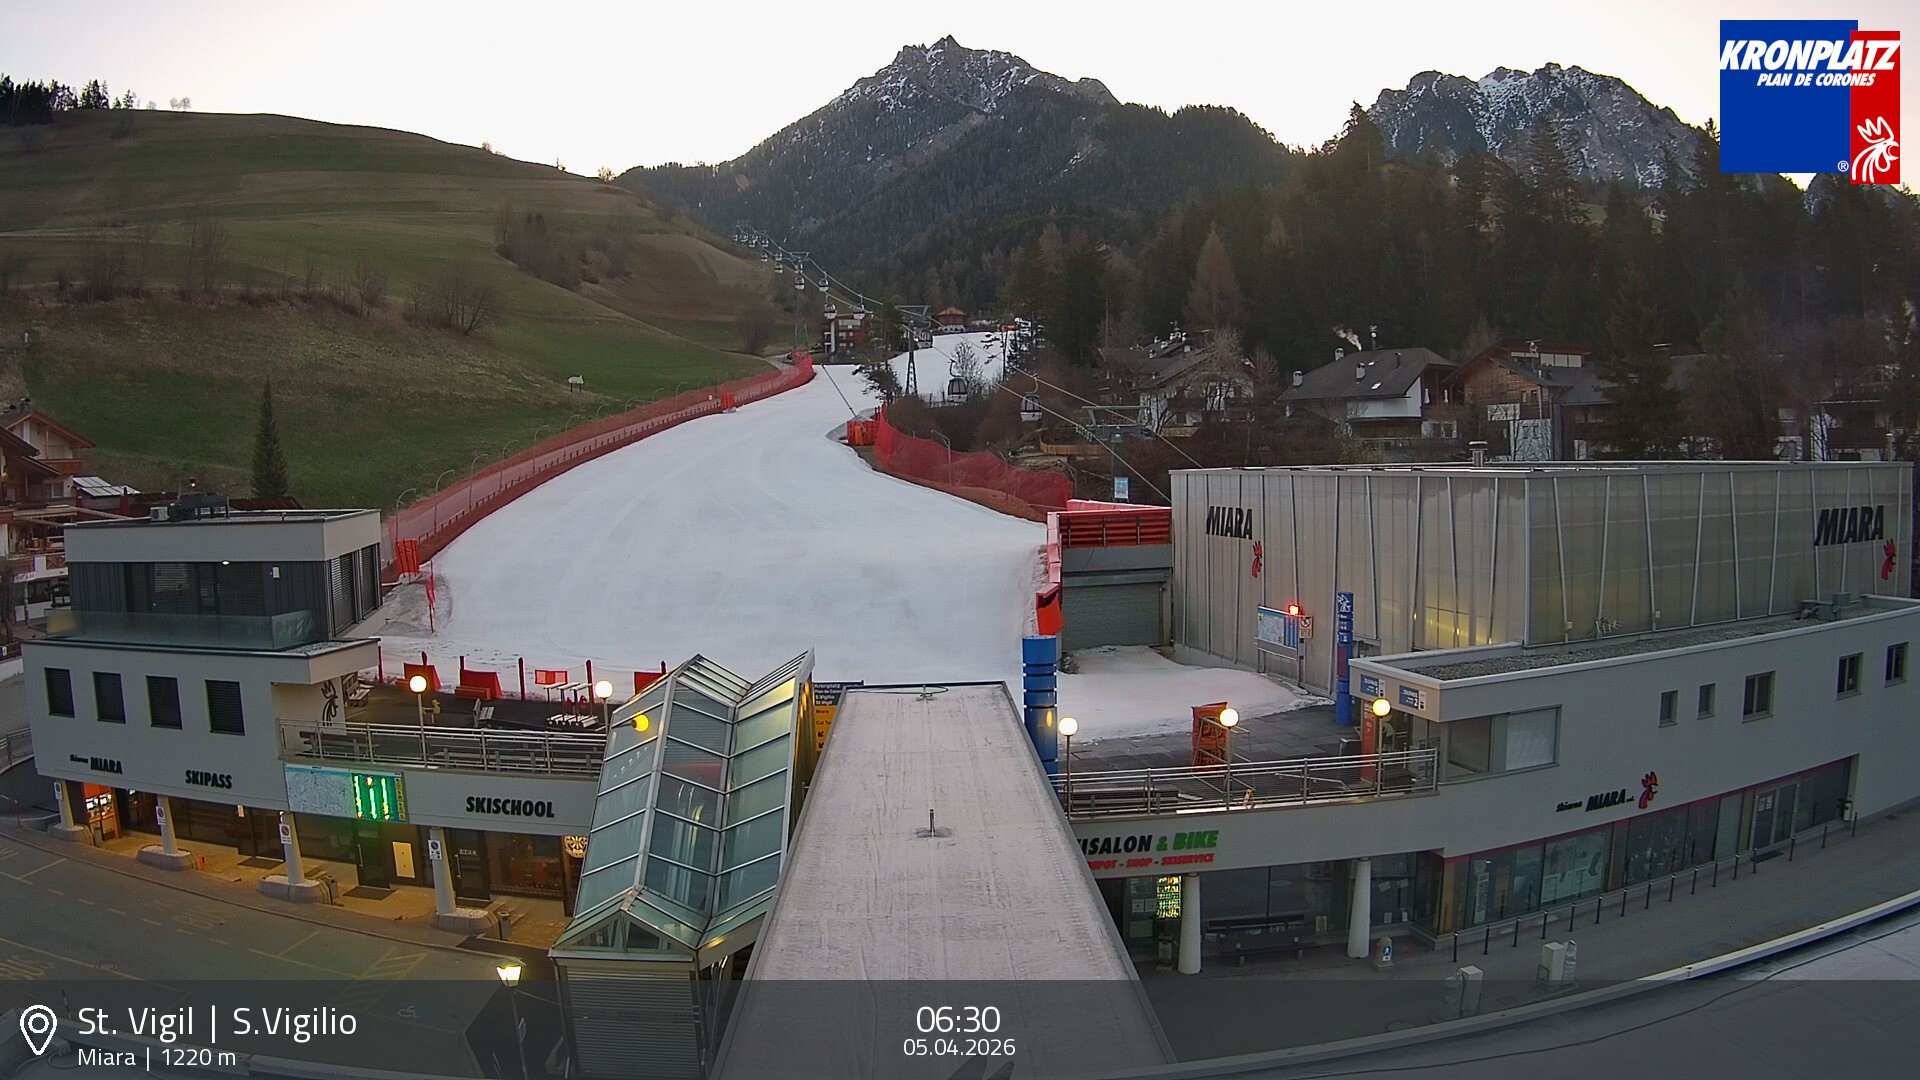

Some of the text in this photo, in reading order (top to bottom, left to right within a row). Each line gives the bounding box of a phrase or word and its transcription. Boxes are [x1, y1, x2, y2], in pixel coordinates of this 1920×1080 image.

[1206, 505, 1253, 540] MIARA
[1813, 505, 1885, 546] MIARA
[91, 757, 122, 775] MIARA
[186, 770, 232, 789] SKIPASS
[466, 797, 555, 818] SKISCHOOL
[1586, 789, 1626, 812] MIARA
[1156, 836, 1168, 851] &
[1173, 830, 1219, 850] BIKE
